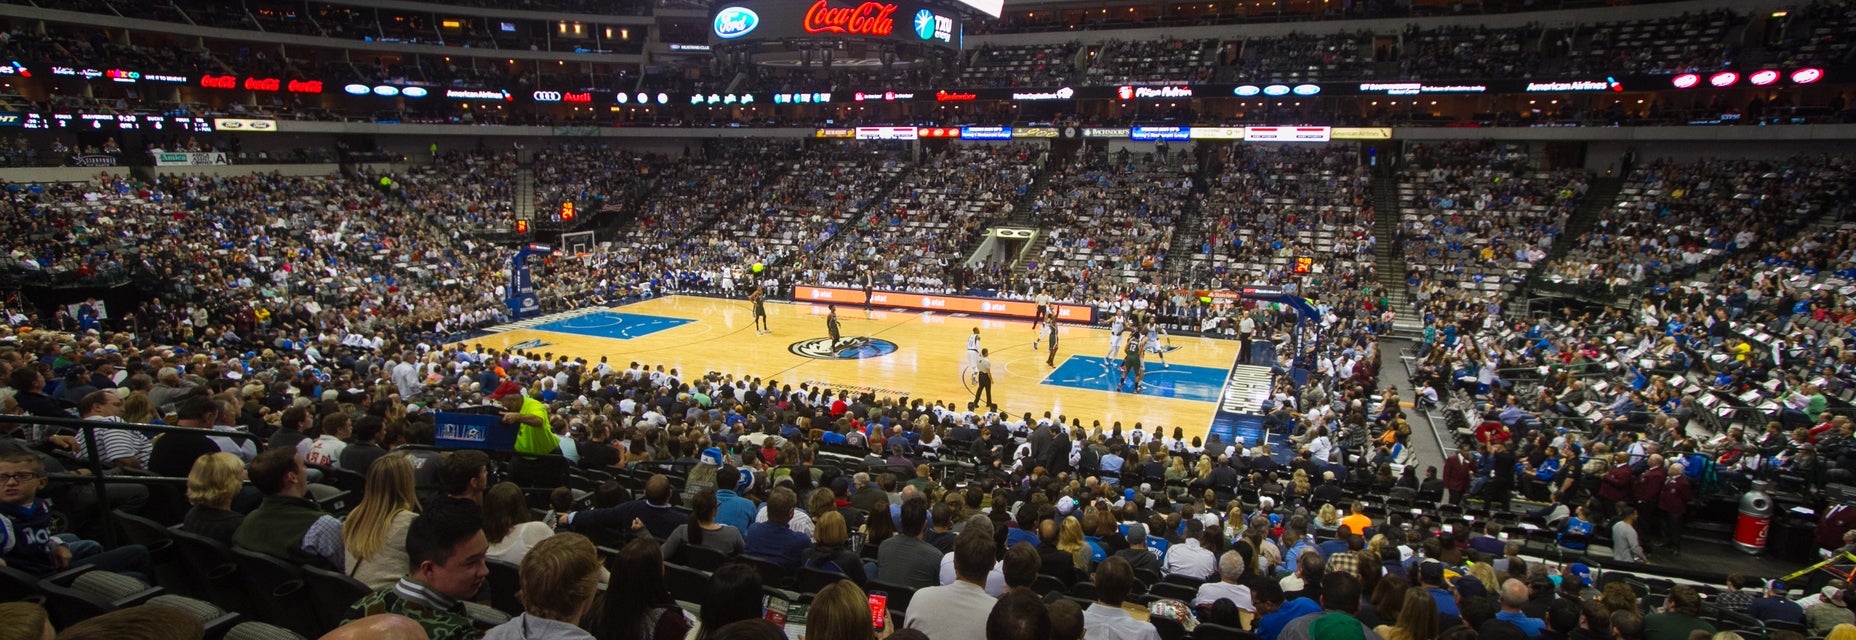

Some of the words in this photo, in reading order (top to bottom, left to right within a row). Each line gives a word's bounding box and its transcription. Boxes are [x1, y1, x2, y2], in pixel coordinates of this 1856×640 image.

[803, 0, 898, 35] Coca-Cola
[719, 13, 747, 33] Ford
[935, 15, 953, 32] TXU
[934, 31, 952, 42] energy
[0, 66, 14, 74] es
[201, 74, 236, 89] Coca-Cola
[244, 77, 280, 92] Coca-Cola
[287, 80, 323, 94] Coca-Cola
[1136, 87, 1162, 97] Pizza
[1526, 82, 1571, 93] American
[1571, 81, 1608, 91] Airlines
[447, 89, 477, 98] American
[477, 90, 503, 100] Airlines
[564, 92, 591, 102] Audi
[59, 120, 66, 128] 2
[93, 120, 101, 129] 6
[154, 122, 162, 130] 6
[216, 154, 226, 164] A
[562, 208, 572, 218] 24
[1297, 263, 1308, 272] 24
[1129, 344, 1137, 353] 12
